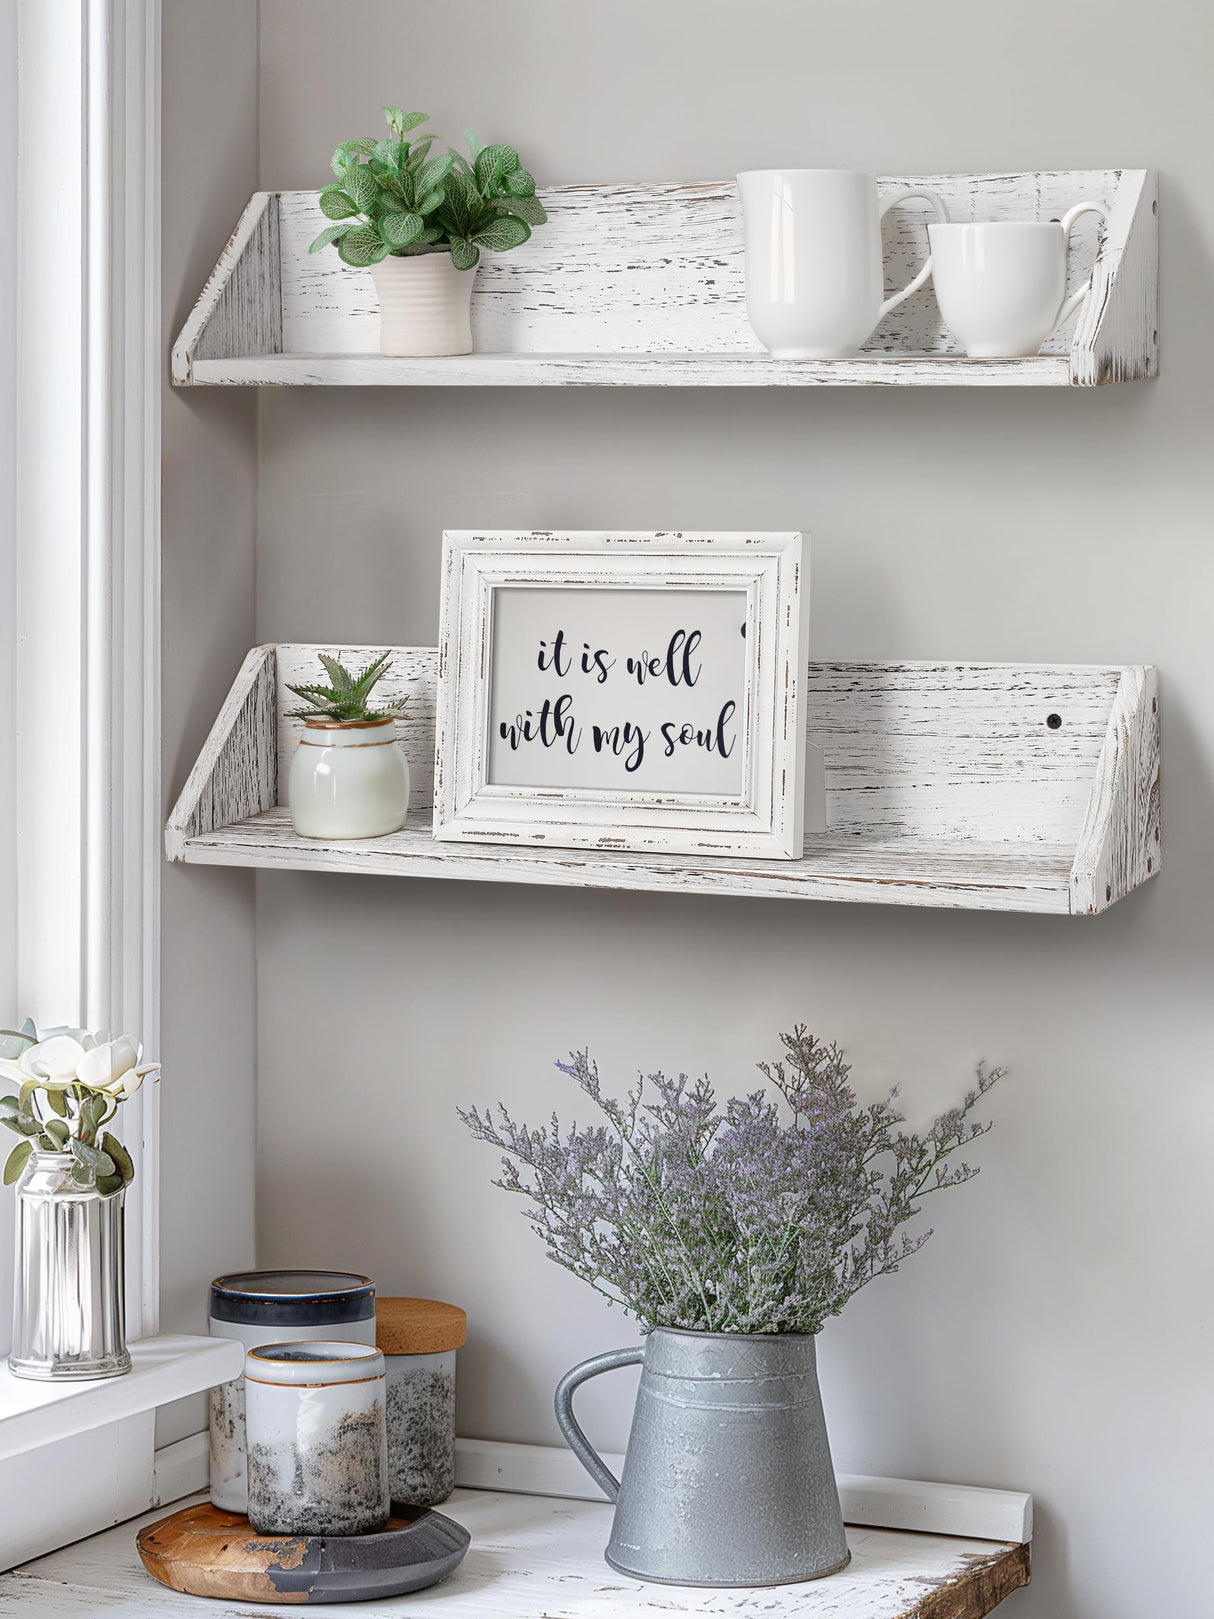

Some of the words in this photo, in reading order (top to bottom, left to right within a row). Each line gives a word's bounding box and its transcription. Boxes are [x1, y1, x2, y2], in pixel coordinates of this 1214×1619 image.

[537, 629, 572, 678] it
[581, 643, 615, 684] is
[627, 629, 702, 687] well
[499, 694, 581, 755] with
[592, 721, 650, 773] my
[660, 700, 736, 759] soul
